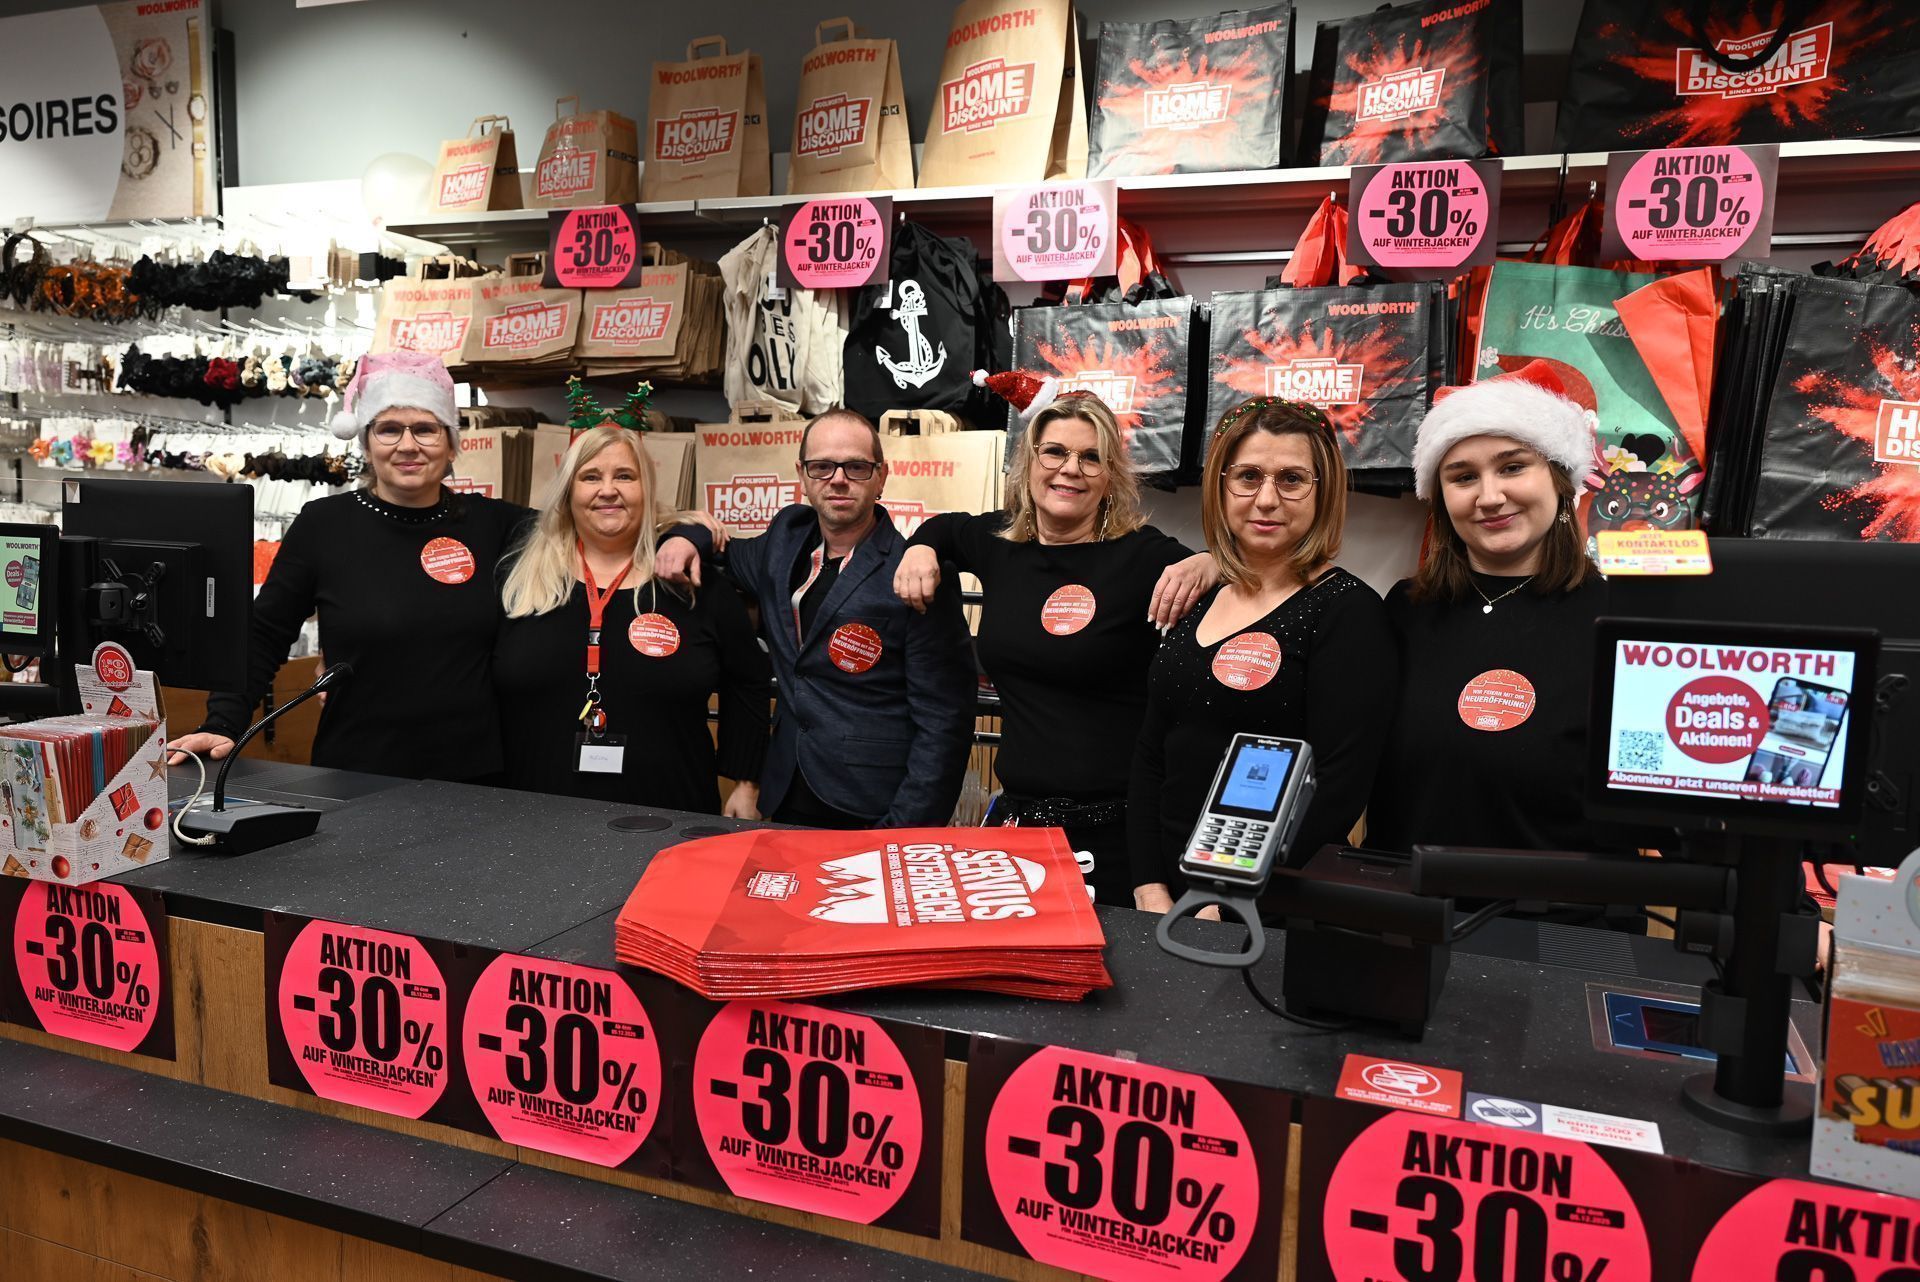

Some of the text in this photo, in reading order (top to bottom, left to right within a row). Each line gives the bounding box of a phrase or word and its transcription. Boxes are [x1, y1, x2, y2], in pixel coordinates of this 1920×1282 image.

[137, 0, 199, 16] WOOLWORTH
[1205, 20, 1279, 44] WOOLWORTH
[658, 64, 743, 85] WOOLWORTH
[1688, 61, 1817, 90] DISCOUNT
[950, 69, 1025, 112] HOME
[1152, 90, 1223, 112] HOME
[1364, 75, 1436, 106] HOME
[948, 97, 1024, 128] DISCOUNT
[1363, 94, 1433, 116] DISCOUNT
[663, 117, 731, 145] HOME
[801, 104, 861, 137] HOME
[661, 138, 728, 157] DISCOUNT
[801, 127, 860, 151] DISCOUNT
[540, 156, 591, 184] HOME
[1654, 154, 1730, 176] AKTION
[445, 171, 485, 194] HOME
[540, 177, 590, 193] DISCOUNT
[1391, 169, 1459, 189] AKTION
[443, 188, 483, 204] DISCOUNT
[1029, 189, 1084, 209] AKTION
[1629, 176, 1750, 229] -30%
[577, 211, 618, 230] AKTION
[811, 204, 861, 221] AKTION
[1369, 189, 1478, 238] -30%
[1012, 208, 1100, 253] -30%
[1632, 229, 1653, 240] AUF
[562, 228, 631, 268] -30%
[794, 221, 876, 263] -30%
[1373, 238, 1391, 247] AUF
[797, 263, 812, 271] AUF
[1016, 254, 1032, 263] AUF
[394, 288, 472, 301] WOOLWORTH
[600, 307, 664, 328] HOME
[1328, 302, 1416, 316] WOOLWORTH
[397, 320, 464, 340] HOME
[493, 310, 560, 335] HOME
[596, 326, 661, 338] DISCOUNT
[1108, 316, 1179, 332] WOOLWORTH
[490, 326, 560, 346] DISCOUNT
[1275, 369, 1353, 389] HOME
[460, 438, 493, 451] ORTH
[703, 430, 803, 447] WOOLWORTH
[714, 485, 796, 510] HOME
[6, 542, 39, 550] WOOLWORTH
[1617, 539, 1699, 548] KONTAKTLOS
[1219, 654, 1274, 669] NEUERÖFFNUNG!
[1623, 644, 1835, 676] WOOLWORTH
[1464, 695, 1528, 710] NEUERÖFFNUNG!
[1682, 691, 1750, 707] Angebote,
[1675, 706, 1759, 730] Deals &
[1679, 732, 1752, 748] Aktionen!
[1610, 771, 1835, 800] Abonniere jetzt unseren Newsletter!
[769, 873, 789, 899] HOME
[902, 844, 967, 923] ÖSTERREICH!
[951, 850, 1037, 921] SERVUS
[47, 884, 121, 926] AKTION
[26, 915, 150, 1006] -30%
[320, 933, 411, 981] AKTION
[34, 986, 55, 1002] AUF
[508, 968, 612, 1018] AKTION
[294, 967, 443, 1071] -30%
[746, 1009, 865, 1066] AKTION
[302, 1045, 327, 1064] AUF
[479, 1004, 647, 1114] -30%
[487, 1087, 515, 1107] AUF
[1053, 1063, 1196, 1129] AKTION
[710, 1048, 904, 1170] -30%
[1570, 1127, 1633, 1142] Scheine
[1603, 1126, 1631, 1135] 200
[719, 1135, 752, 1158] AUF
[1008, 1105, 1236, 1243] -30%
[1402, 1129, 1573, 1199] AKTION
[1016, 1196, 1053, 1218] AUF
